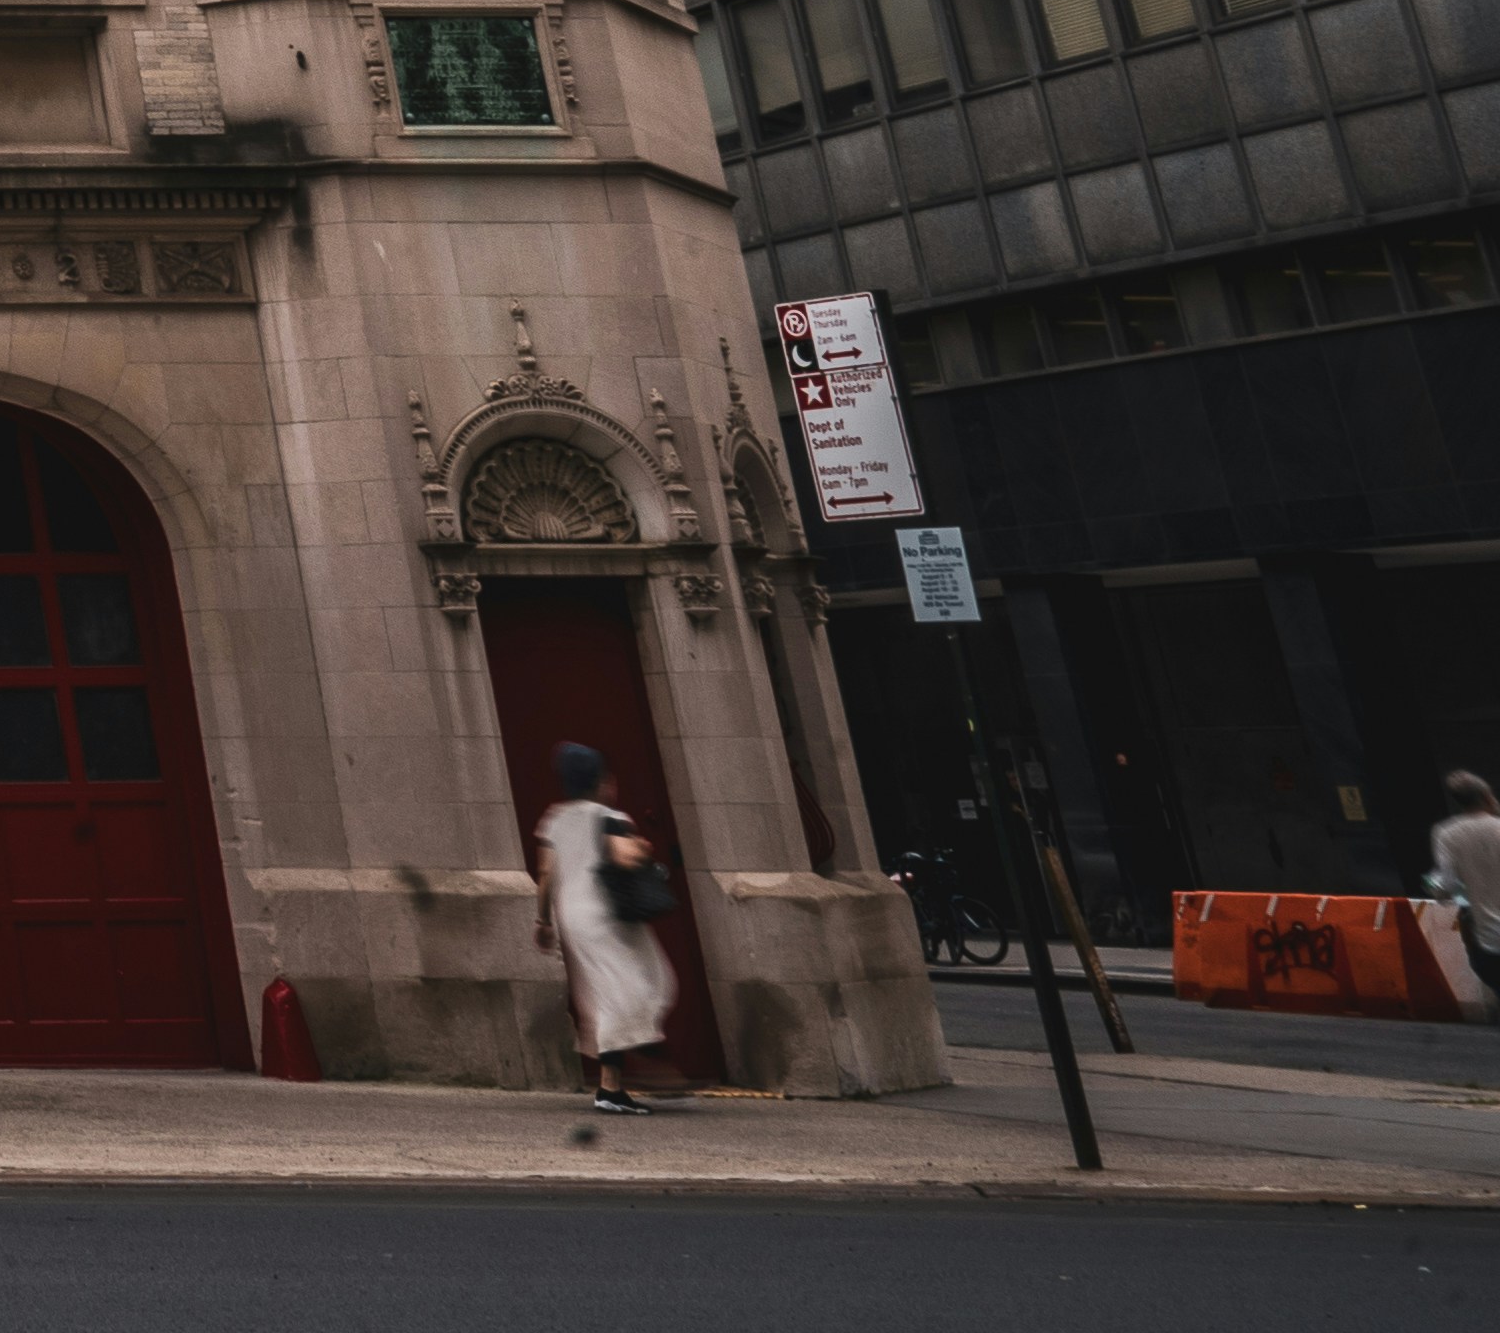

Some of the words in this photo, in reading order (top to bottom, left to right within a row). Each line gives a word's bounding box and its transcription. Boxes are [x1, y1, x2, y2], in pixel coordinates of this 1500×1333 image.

[55, 251, 81, 284] 2
[810, 308, 841, 318] Tuesday
[813, 319, 848, 329] Thursday
[829, 367, 883, 383] Authorized
[833, 383, 872, 396] Vehicles
[835, 397, 856, 408] Only
[808, 420, 832, 434] Dept
[833, 418, 845, 431] of
[811, 435, 863, 450] Sanitation
[818, 464, 853, 477] Monday
[860, 461, 888, 473] Friday
[821, 478, 842, 490] 6am
[848, 477, 869, 489] 7pm
[902, 547, 918, 558] No
[919, 545, 963, 558] Parking
